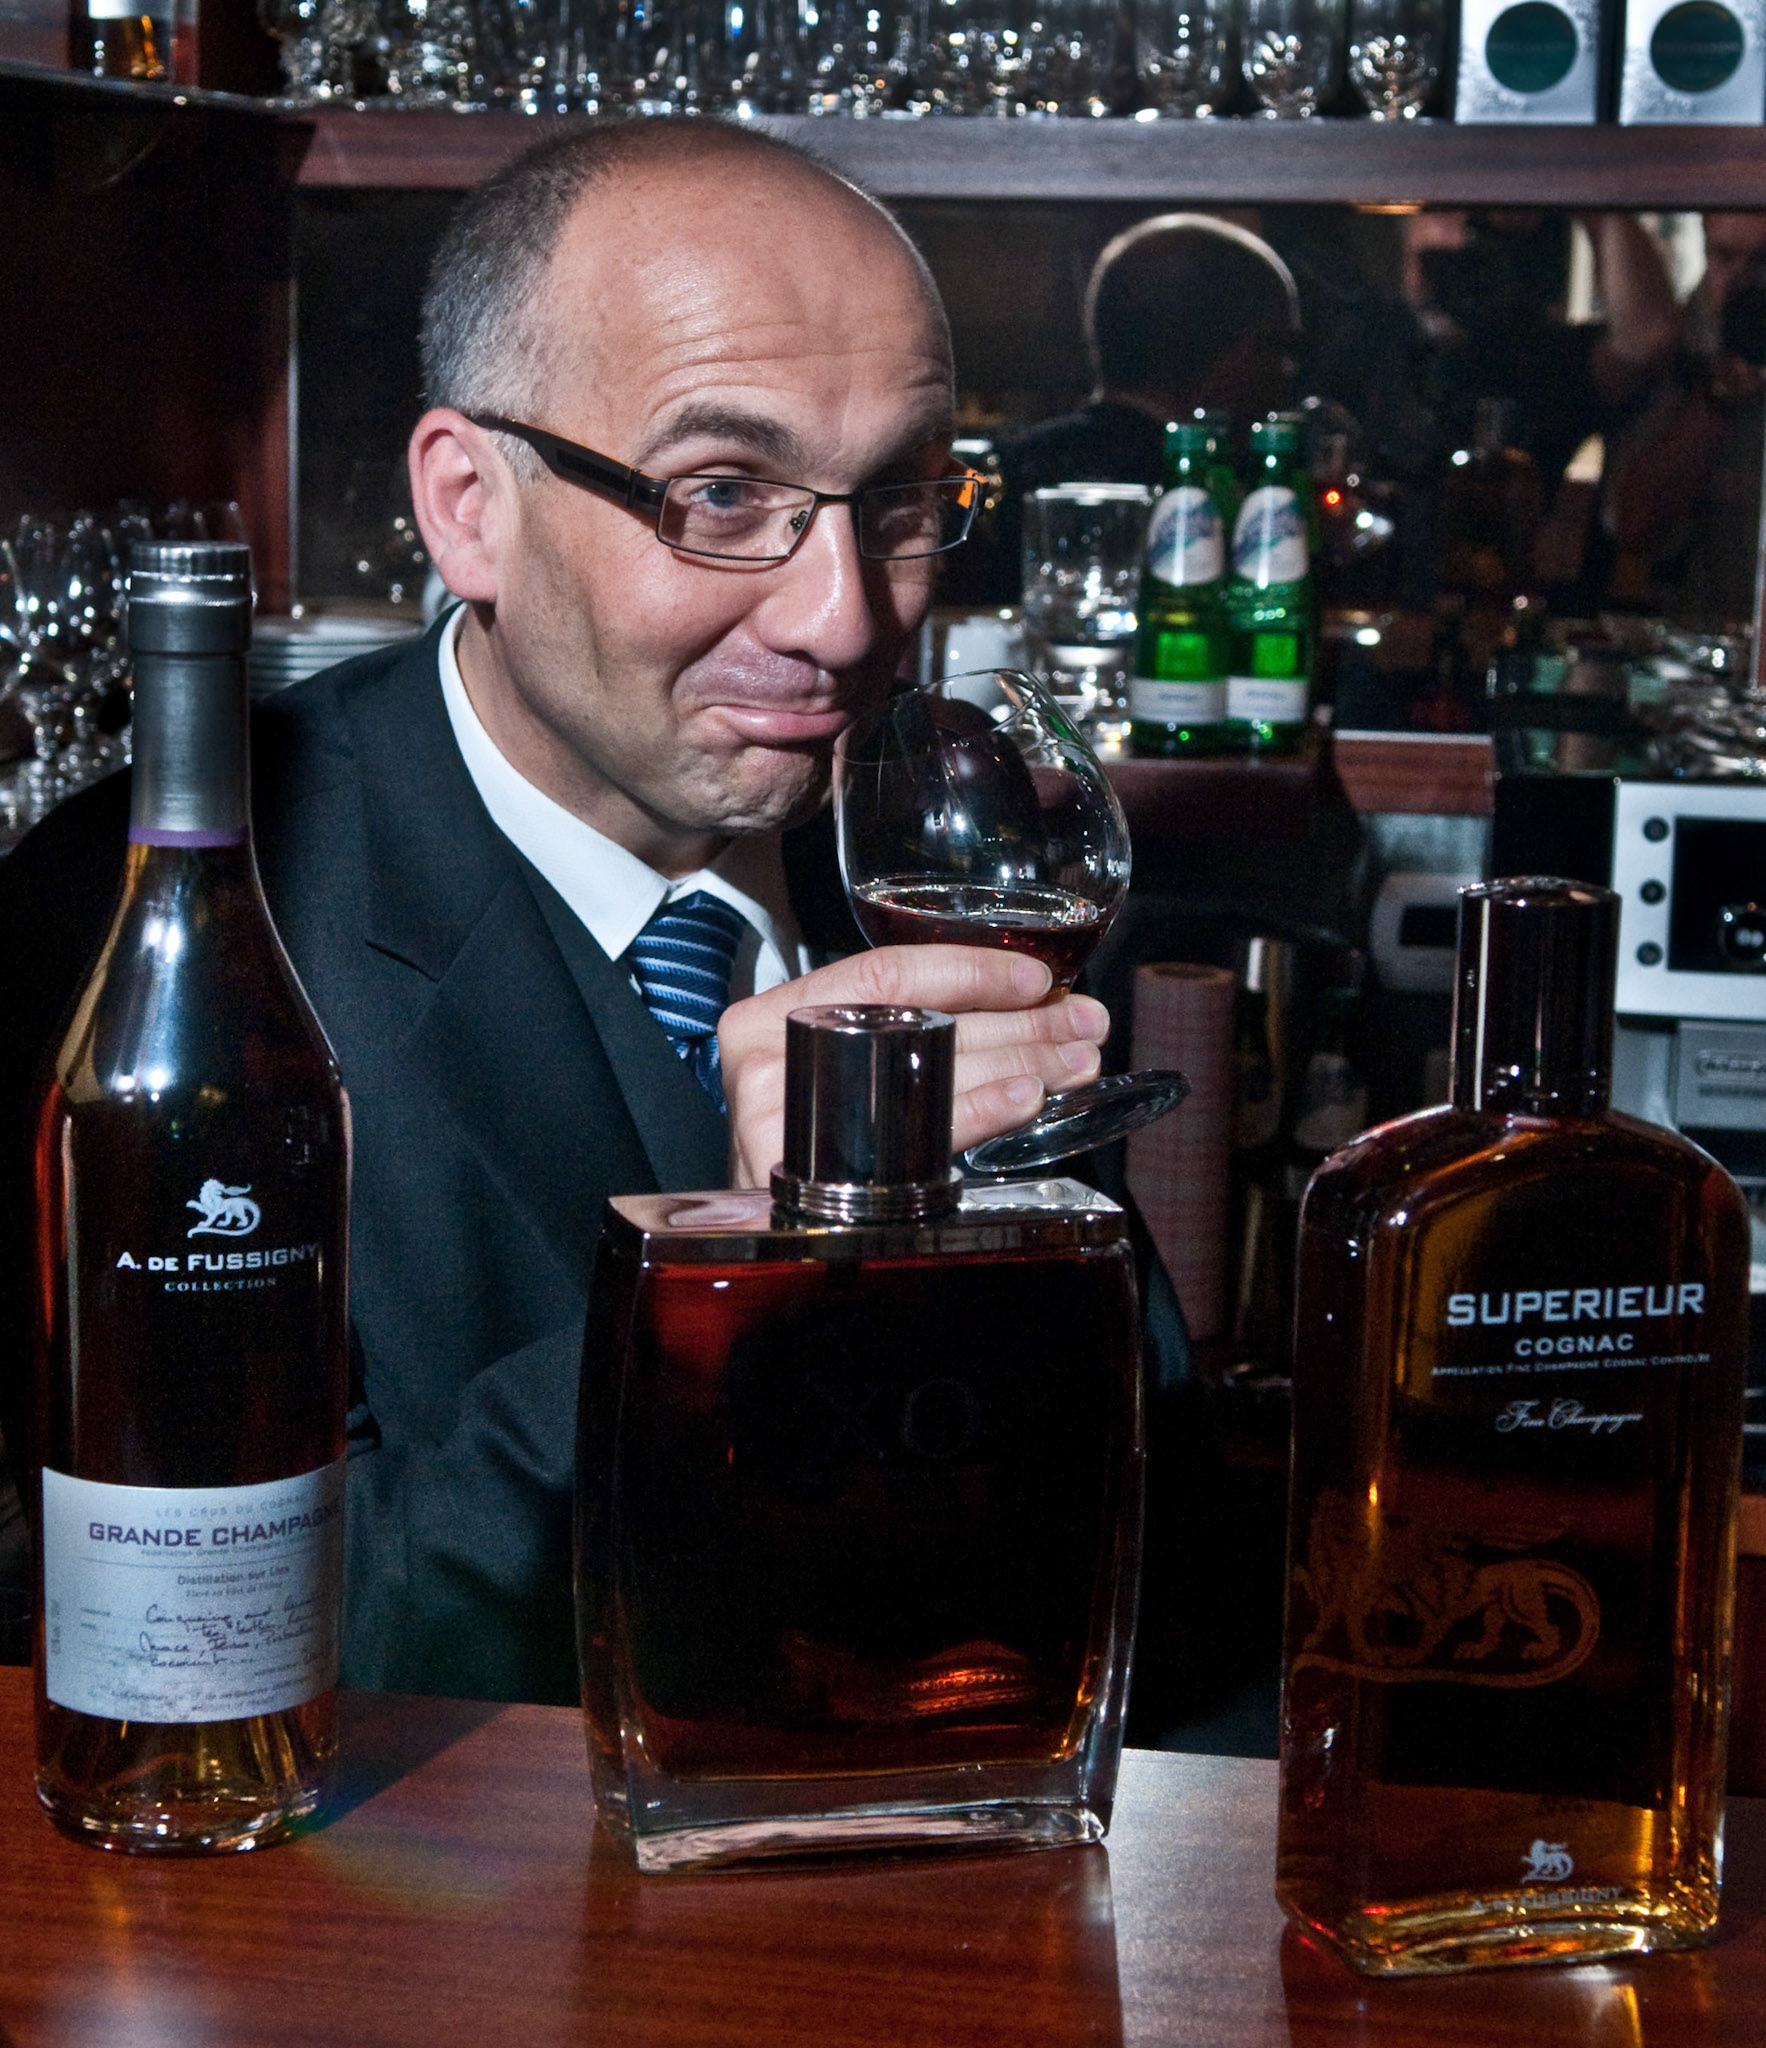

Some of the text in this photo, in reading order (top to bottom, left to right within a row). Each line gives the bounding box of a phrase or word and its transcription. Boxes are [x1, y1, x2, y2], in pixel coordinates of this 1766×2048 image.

[116, 1251, 142, 1270] A.
[187, 1243, 318, 1271] FUSSIGNY
[164, 1277, 277, 1292] COLLECTION
[1447, 1283, 1705, 1326] SUPERIEUR
[1515, 1333, 1634, 1357] COGNAC
[89, 1522, 201, 1547] GRANDE
